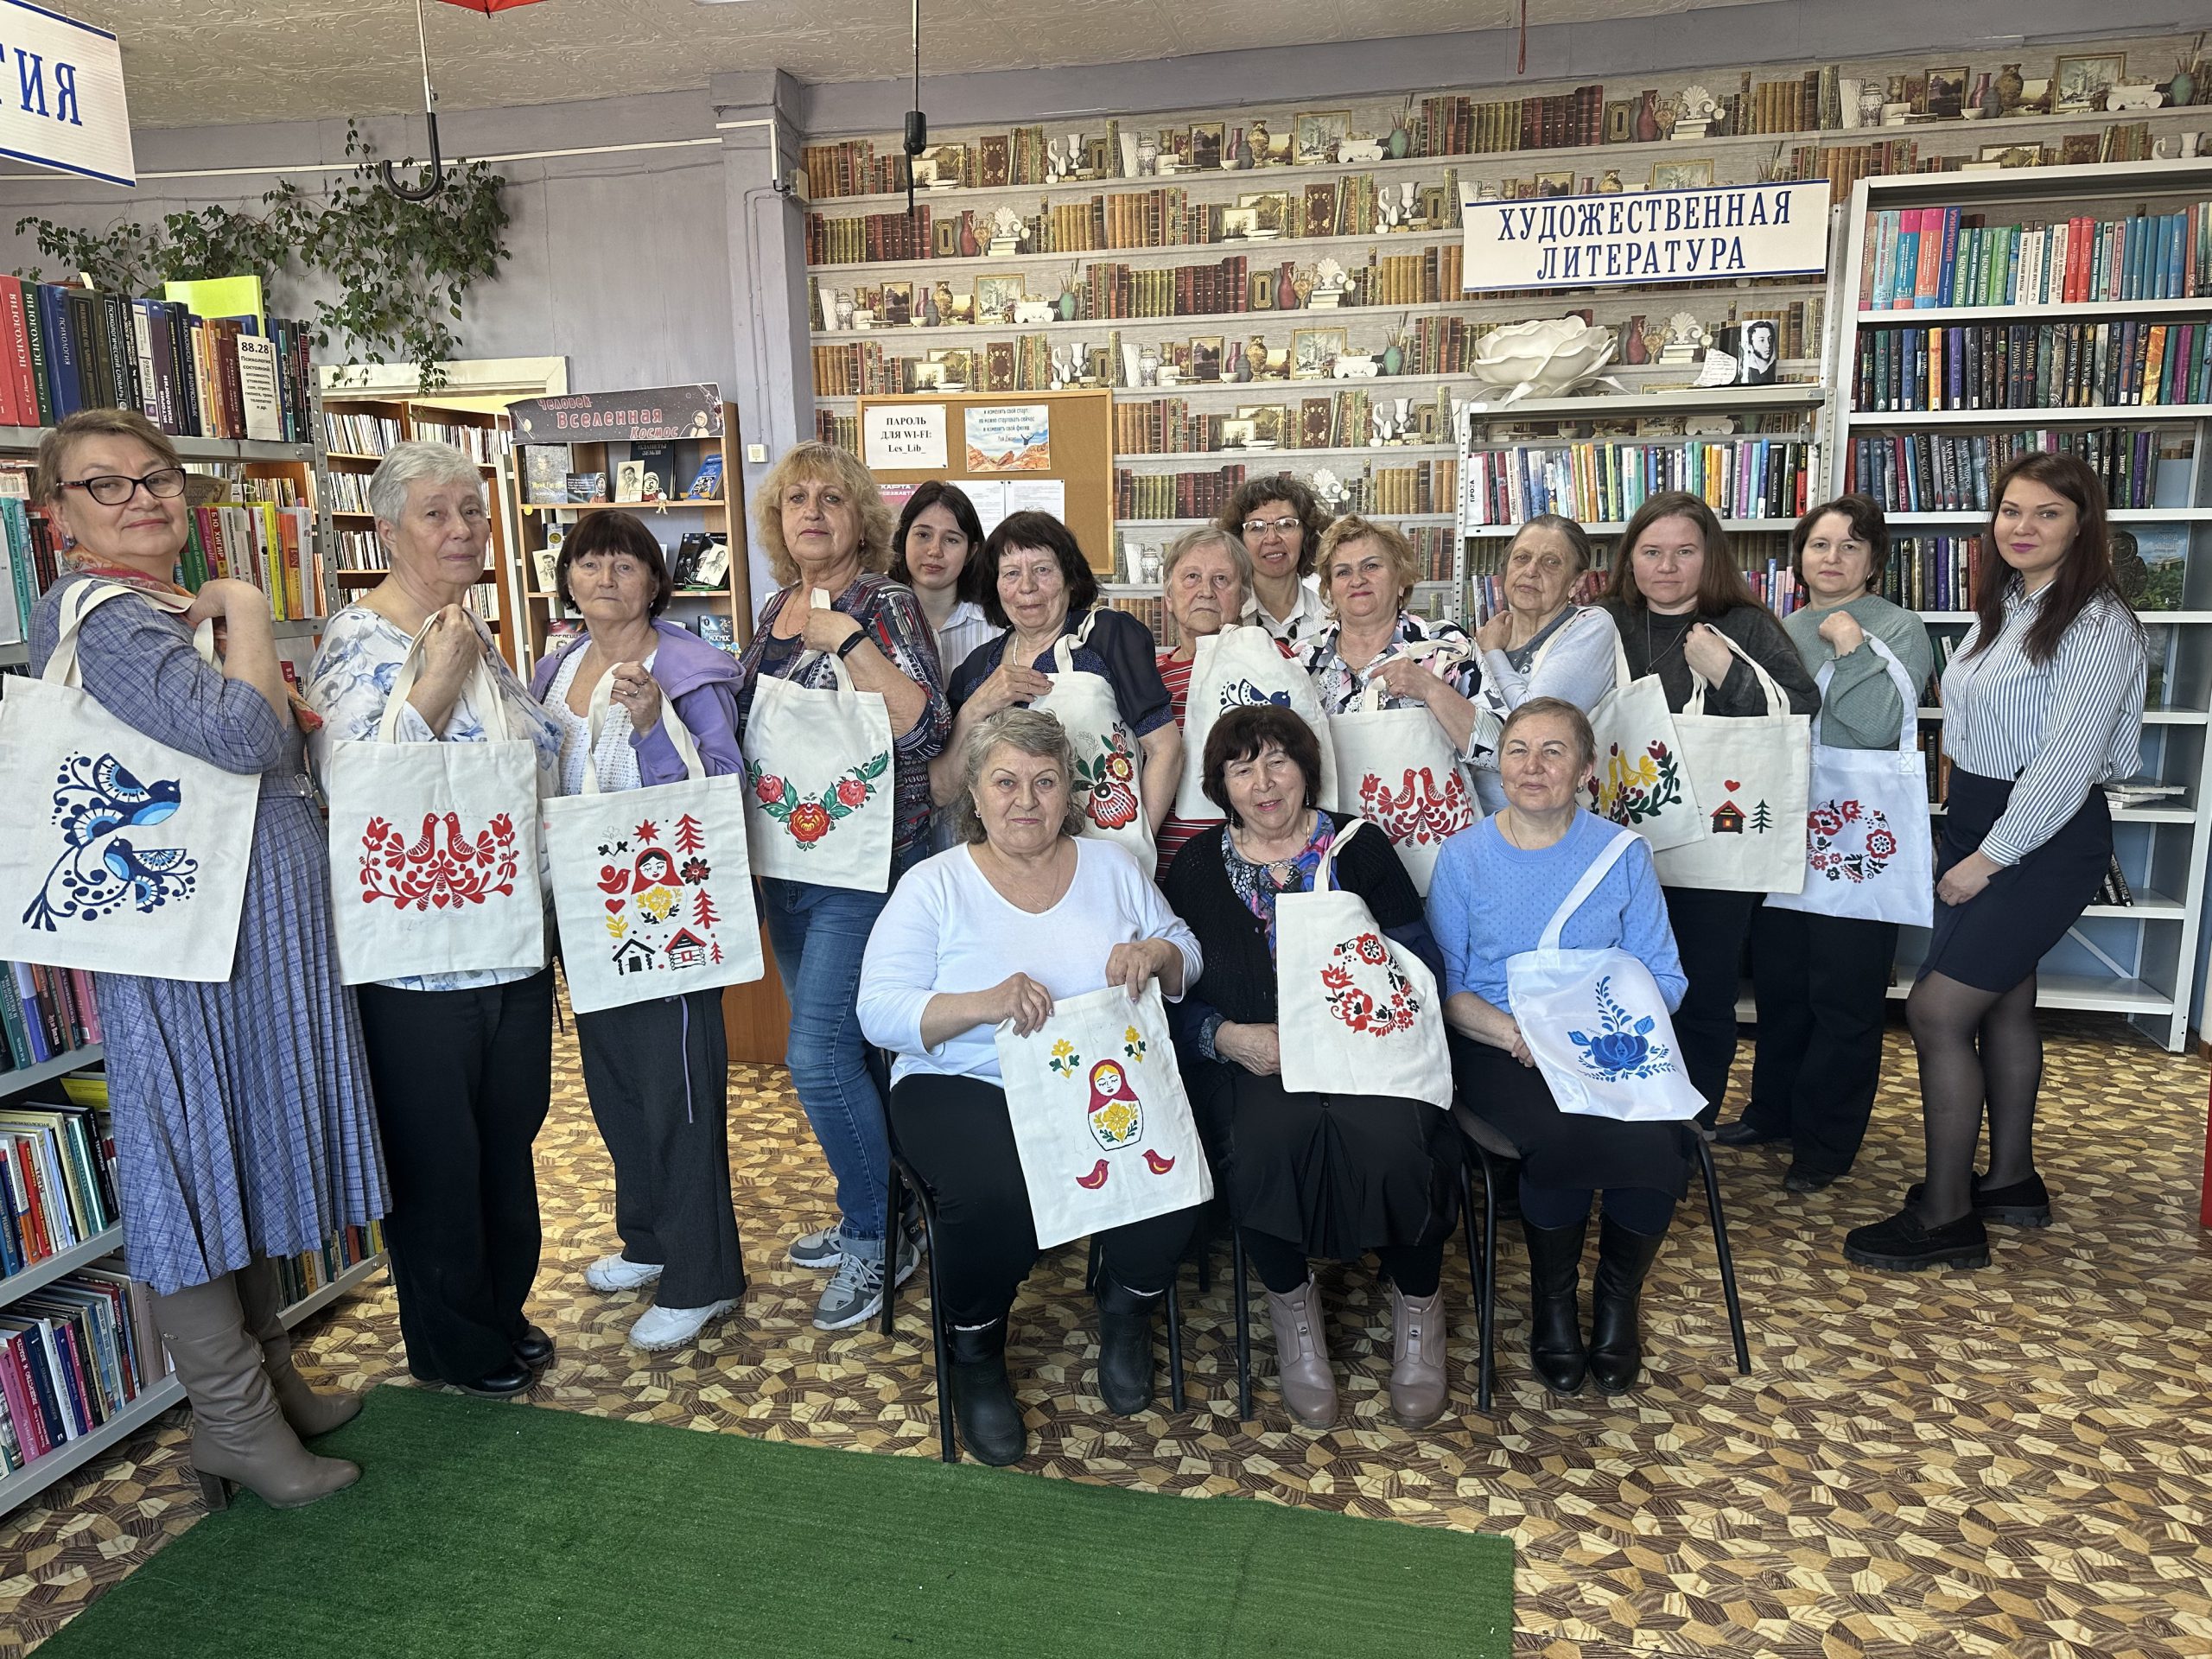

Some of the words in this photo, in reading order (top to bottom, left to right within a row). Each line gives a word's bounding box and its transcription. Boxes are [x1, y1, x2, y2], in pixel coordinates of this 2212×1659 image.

[0, 43, 82, 127] ИЯ
[1497, 189, 1792, 242] ХУДОЖЕСТВЕННАЯ
[1946, 209, 1957, 262] ШКОЛЬНИКА
[1536, 236, 1745, 281] ЛИТЕРАТУРА
[9, 293, 27, 367] ПСИХОЛОГИЯ
[26, 293, 41, 365] ПСИХОЛОГИЯ
[59, 317, 70, 365] ПСИХОЛОГИЯ
[241, 341, 270, 354] 88.28
[108, 305, 119, 368] ПСИХОЛОГИЧЕСКИЙ
[115, 370, 124, 397] СЛОВАРЬ
[163, 375, 173, 423] ПСИХОЛОГИИ
[537, 395, 593, 410] Человек
[556, 408, 663, 429] Вселенная
[630, 424, 679, 440] Космос
[880, 430, 901, 441] ДЛЯ
[904, 429, 932, 439] WI-FI:
[887, 417, 927, 426] ПАРОЛЬ
[215, 531, 224, 557] ХИГИР
[95, 1140, 105, 1171] ТЕРРОРИЗМ
[35, 1167, 44, 1193] ТЕСТЫ
